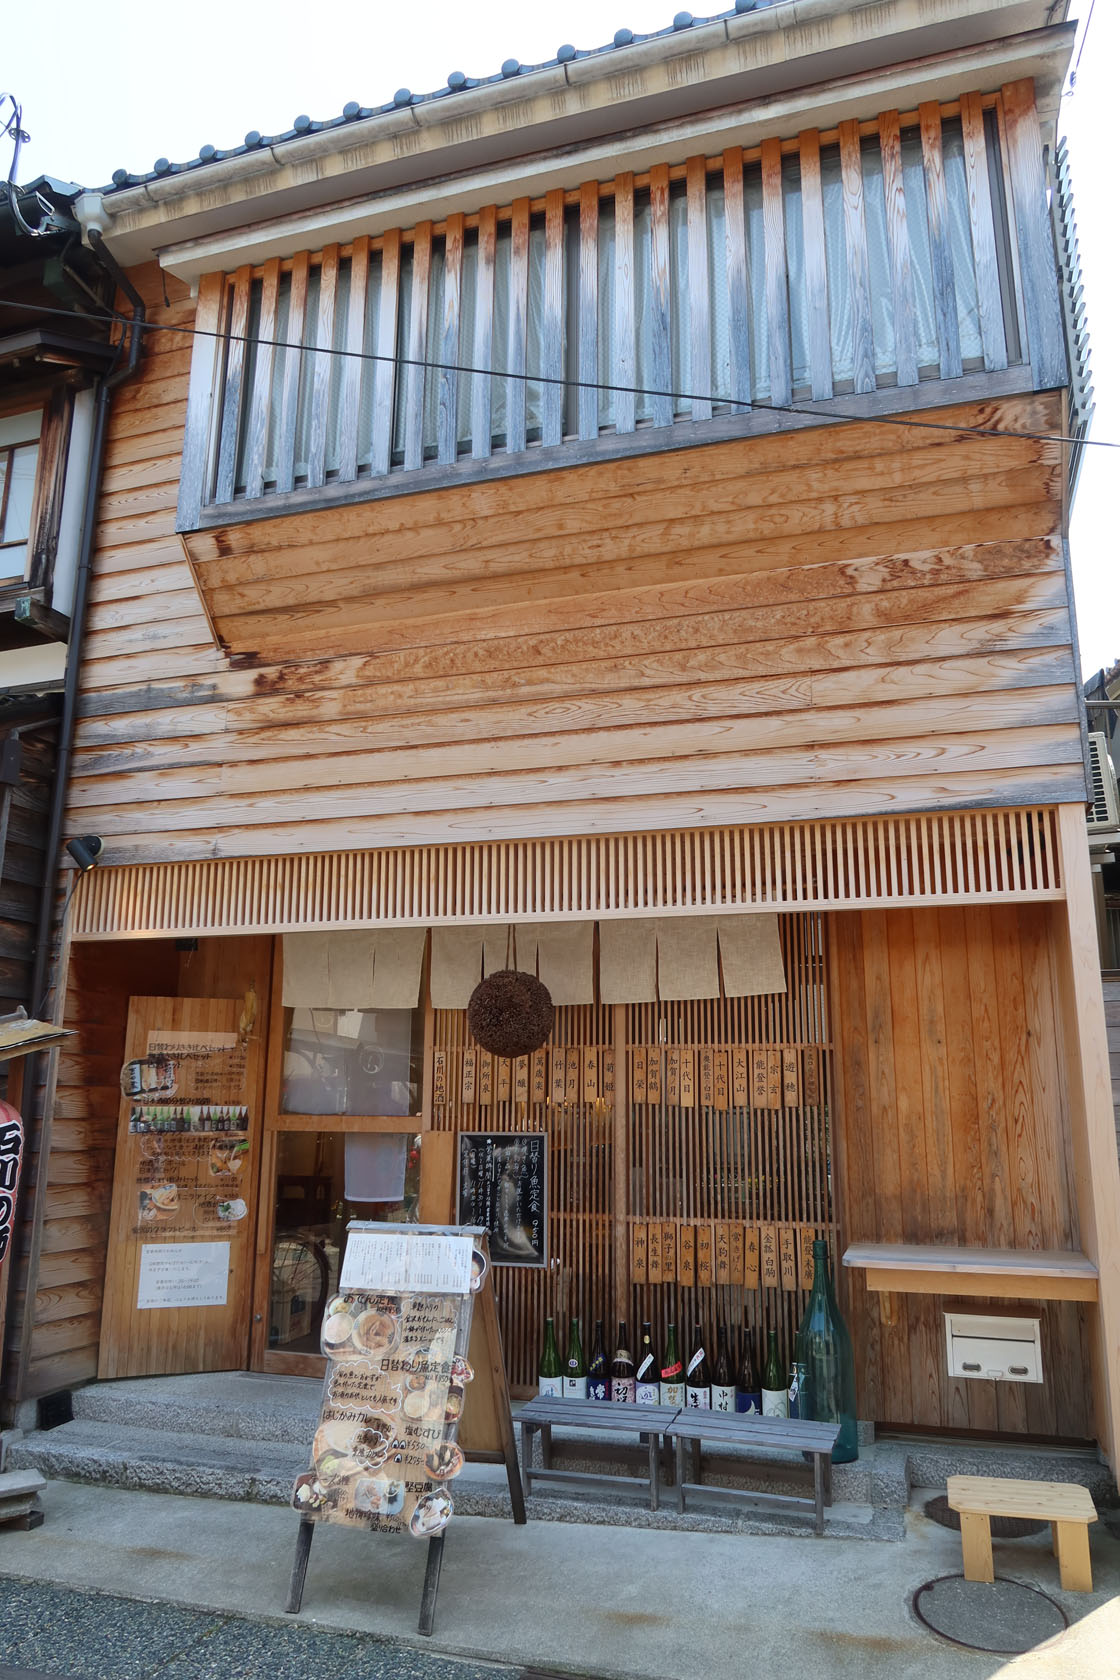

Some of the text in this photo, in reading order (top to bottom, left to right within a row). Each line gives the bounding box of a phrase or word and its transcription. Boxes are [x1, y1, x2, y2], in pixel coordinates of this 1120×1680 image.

[435, 1056, 445, 1103] 石川の地酒
[464, 1057, 474, 1091] 福正宗
[482, 1060, 491, 1093] 御所泉
[554, 1060, 564, 1089] 竹葉
[568, 1061, 577, 1088] 池月
[587, 1060, 597, 1088] 春山
[605, 1063, 616, 1091] 菊姫
[648, 1056, 659, 1092] 加賀鶴
[668, 1056, 678, 1096] 加賀ノ月
[682, 1059, 692, 1093] 十代目
[715, 1061, 726, 1096] 十代目
[735, 1058, 746, 1093] 大江山
[769, 1064, 780, 1094] 宗玄
[528, 1139, 541, 1247] 日替り魚定食 950円
[635, 1237, 645, 1269] 神泉
[650, 1233, 660, 1271] 長生舞
[663, 1232, 674, 1272] 獅子の里
[682, 1239, 693, 1271] 谷泉
[700, 1240, 709, 1272] 初桜
[718, 1234, 728, 1272] 天狗舞
[732, 1231, 741, 1273] 常きげん
[746, 1241, 758, 1272] 春心
[783, 1239, 793, 1277] 手取川
[380, 1358, 451, 1374] 日替わり魚定食
[322, 1409, 382, 1423] はじかみカレー
